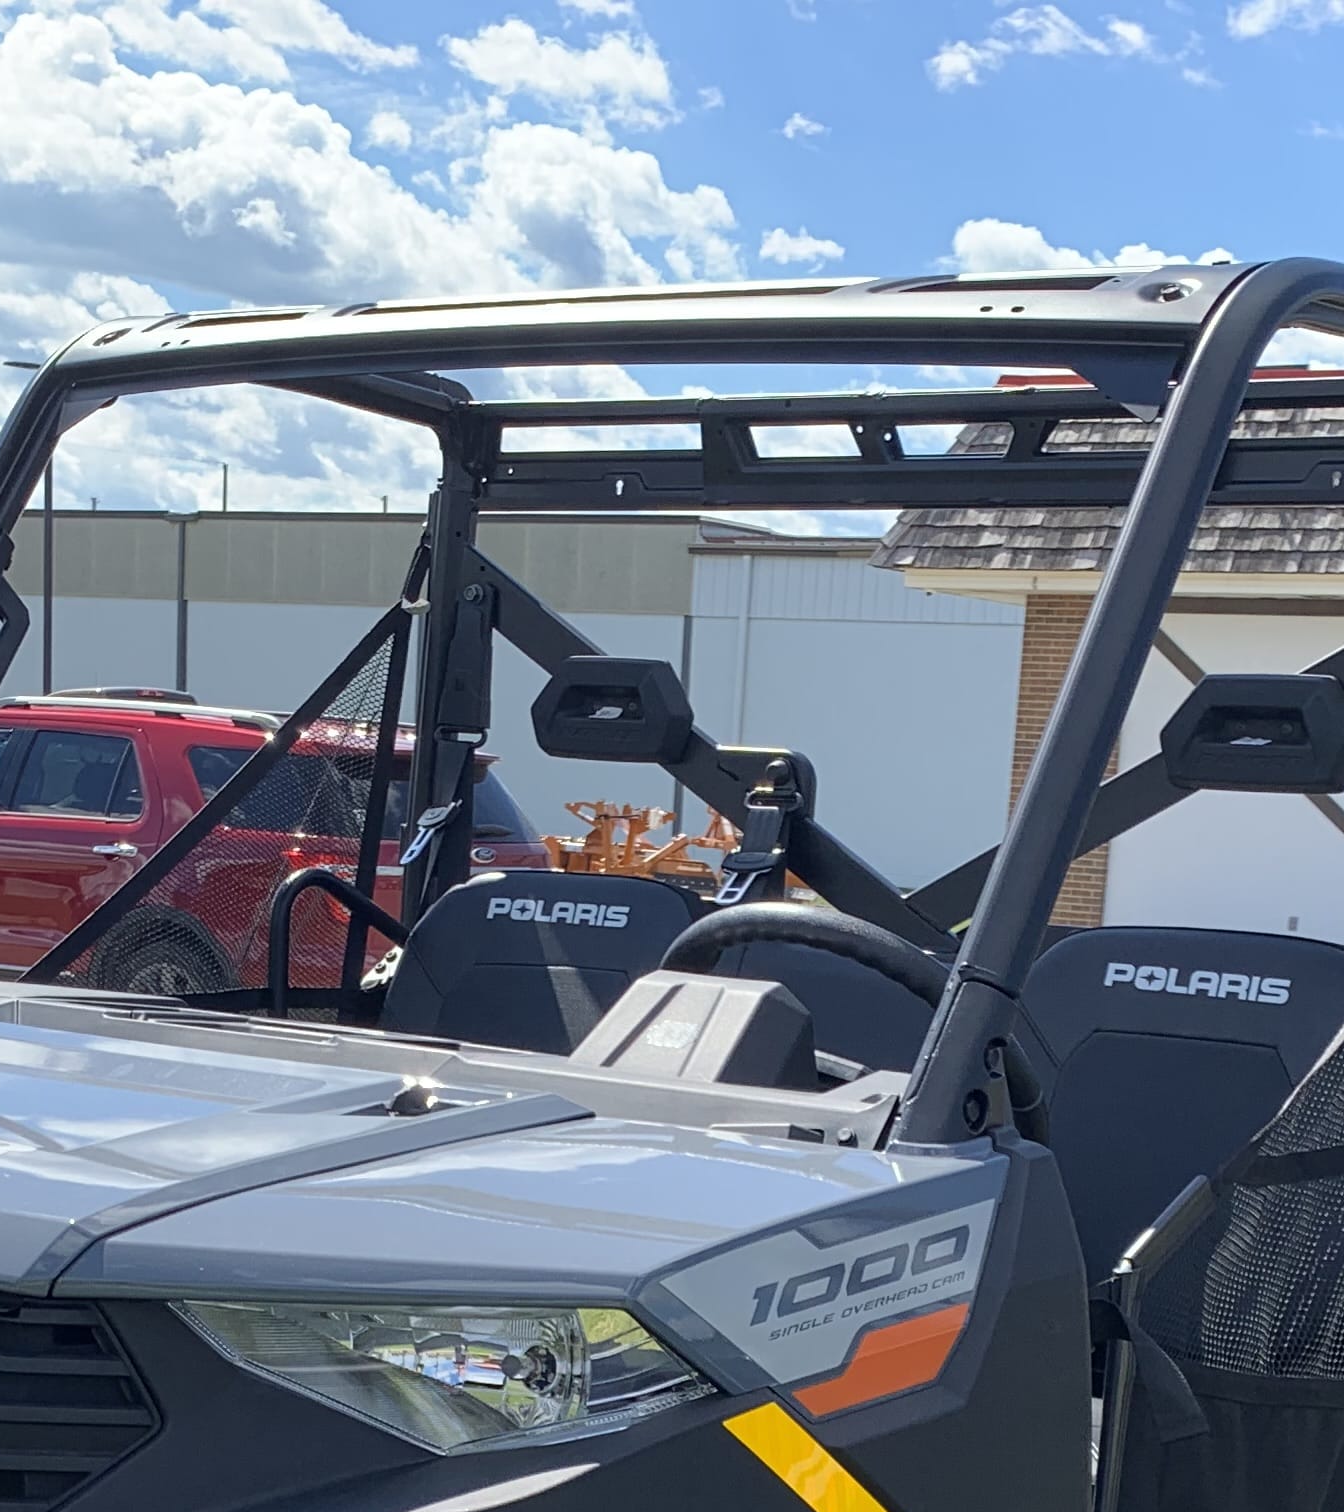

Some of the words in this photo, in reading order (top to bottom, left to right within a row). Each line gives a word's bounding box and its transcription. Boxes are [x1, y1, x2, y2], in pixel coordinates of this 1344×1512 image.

[486, 897, 630, 928] POLARIS
[1103, 962, 1291, 1005] POLARIS
[750, 1224, 970, 1327] 1000
[768, 1312, 835, 1341] SINGLE
[841, 1284, 928, 1319] OVERHEAD
[931, 1271, 965, 1290] CAM
